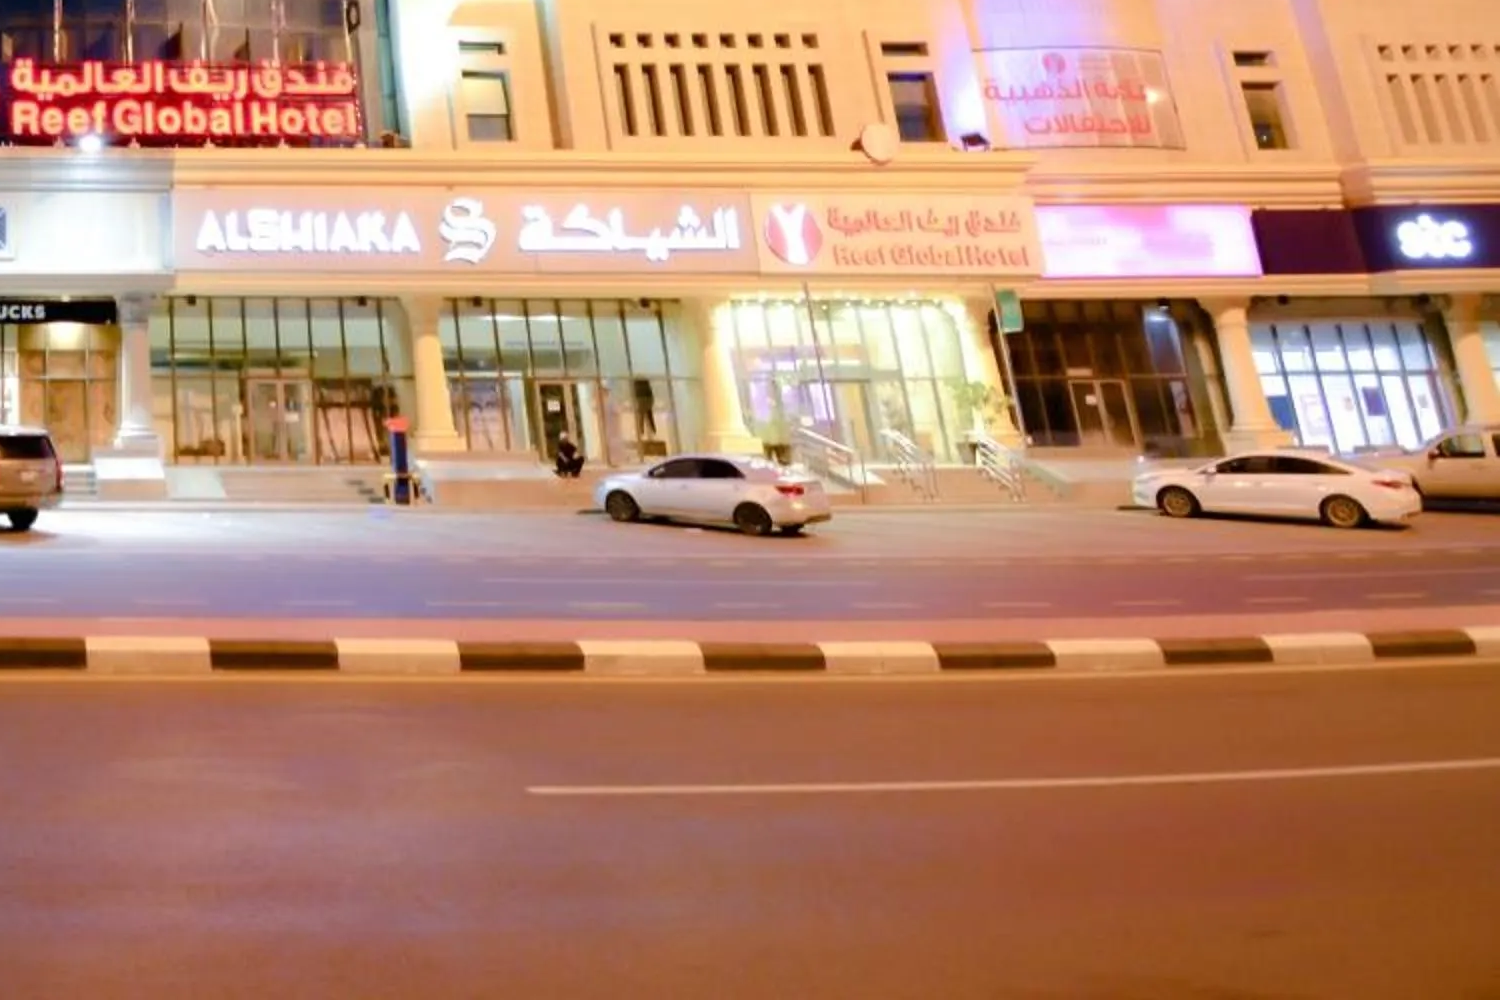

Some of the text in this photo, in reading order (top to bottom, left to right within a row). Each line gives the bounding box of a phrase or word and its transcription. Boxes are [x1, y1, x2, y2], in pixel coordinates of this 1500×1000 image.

[11, 58, 356, 100] فندق ريف العالمية
[12, 99, 358, 136] Reef Global Hotel
[196, 208, 422, 252] ALSHIAKA
[517, 202, 742, 263] الشياكة
